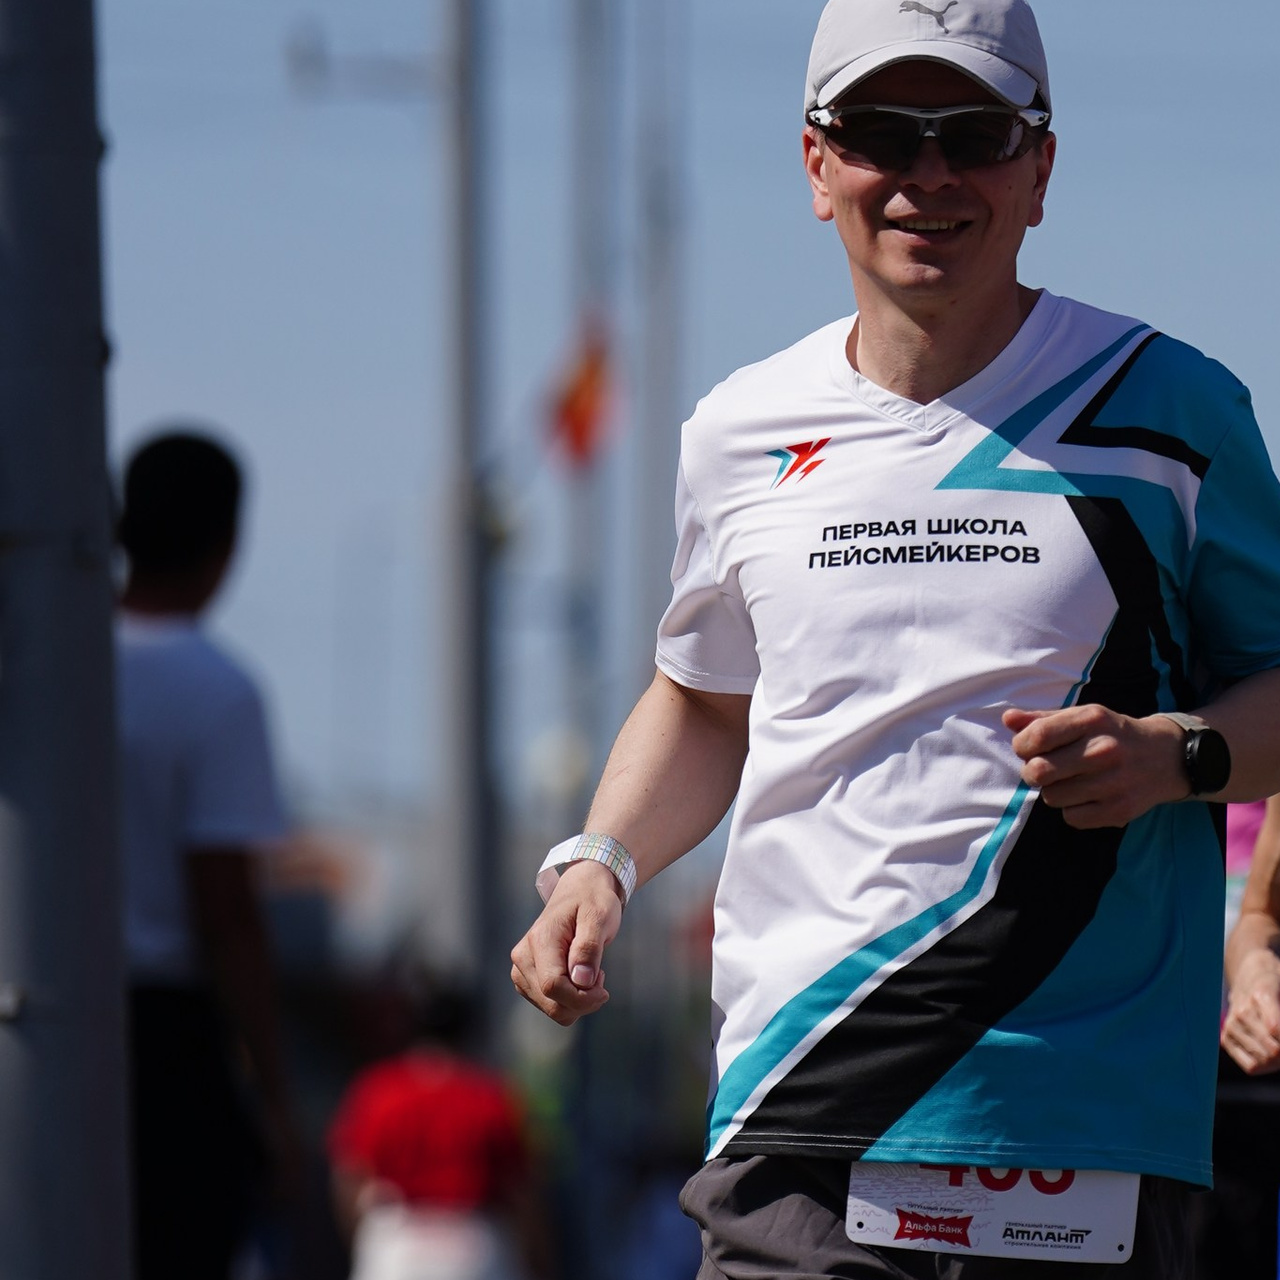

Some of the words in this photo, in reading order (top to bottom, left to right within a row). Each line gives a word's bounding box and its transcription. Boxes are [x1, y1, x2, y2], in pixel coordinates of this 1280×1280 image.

[822, 519, 917, 542] ПЕРВАЯ
[927, 518, 1028, 536] ШКОЛА
[808, 541, 1041, 569] ПЕЙСМЕЙКЕРОВ
[904, 1220, 937, 1233] Альфа
[938, 1223, 963, 1234] Банк
